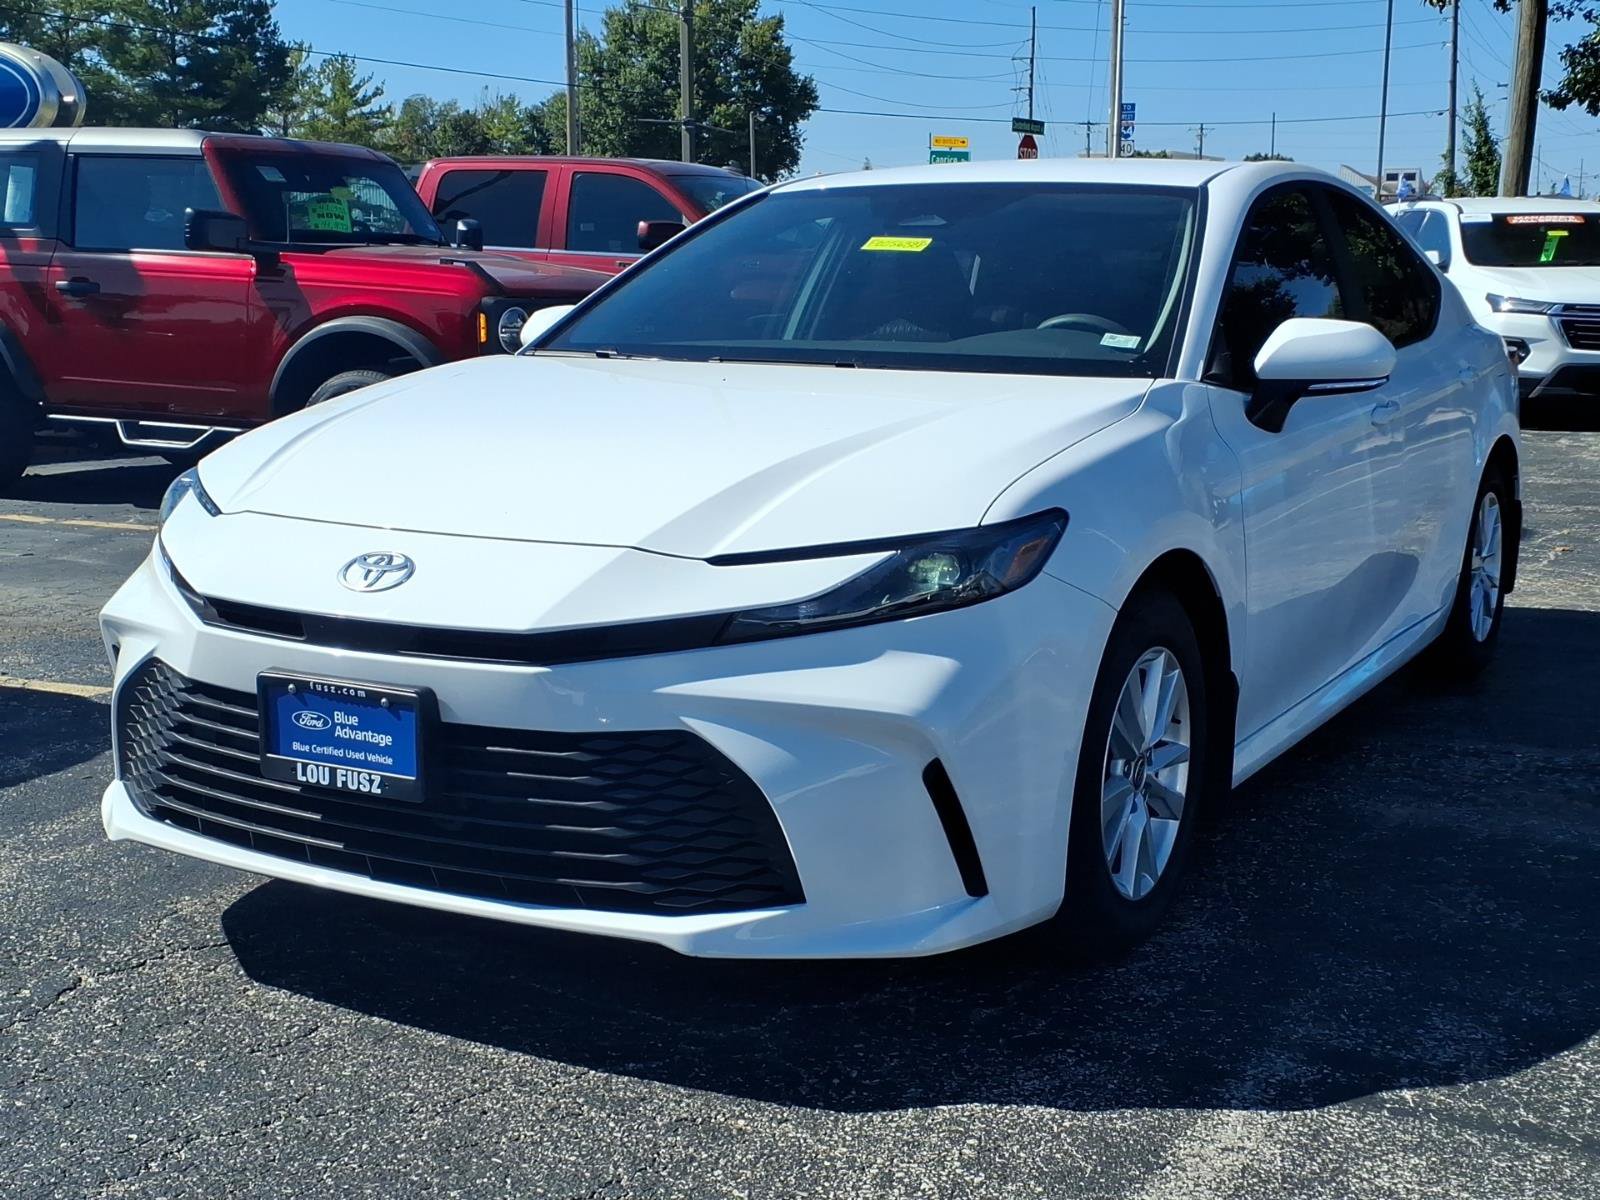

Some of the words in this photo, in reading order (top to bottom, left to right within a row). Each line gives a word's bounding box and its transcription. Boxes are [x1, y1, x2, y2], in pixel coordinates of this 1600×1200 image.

[1019, 147, 1037, 159] STOP
[309, 681, 367, 698] fusz.com
[299, 712, 325, 728] Ford
[333, 710, 359, 726] Blue
[334, 725, 393, 747] Advantage
[292, 741, 310, 752] Blue
[311, 743, 344, 757] Certified
[345, 749, 365, 761] Used
[366, 752, 393, 765] Vehicle
[296, 762, 330, 785] LOU
[336, 769, 382, 794] FUSZ
